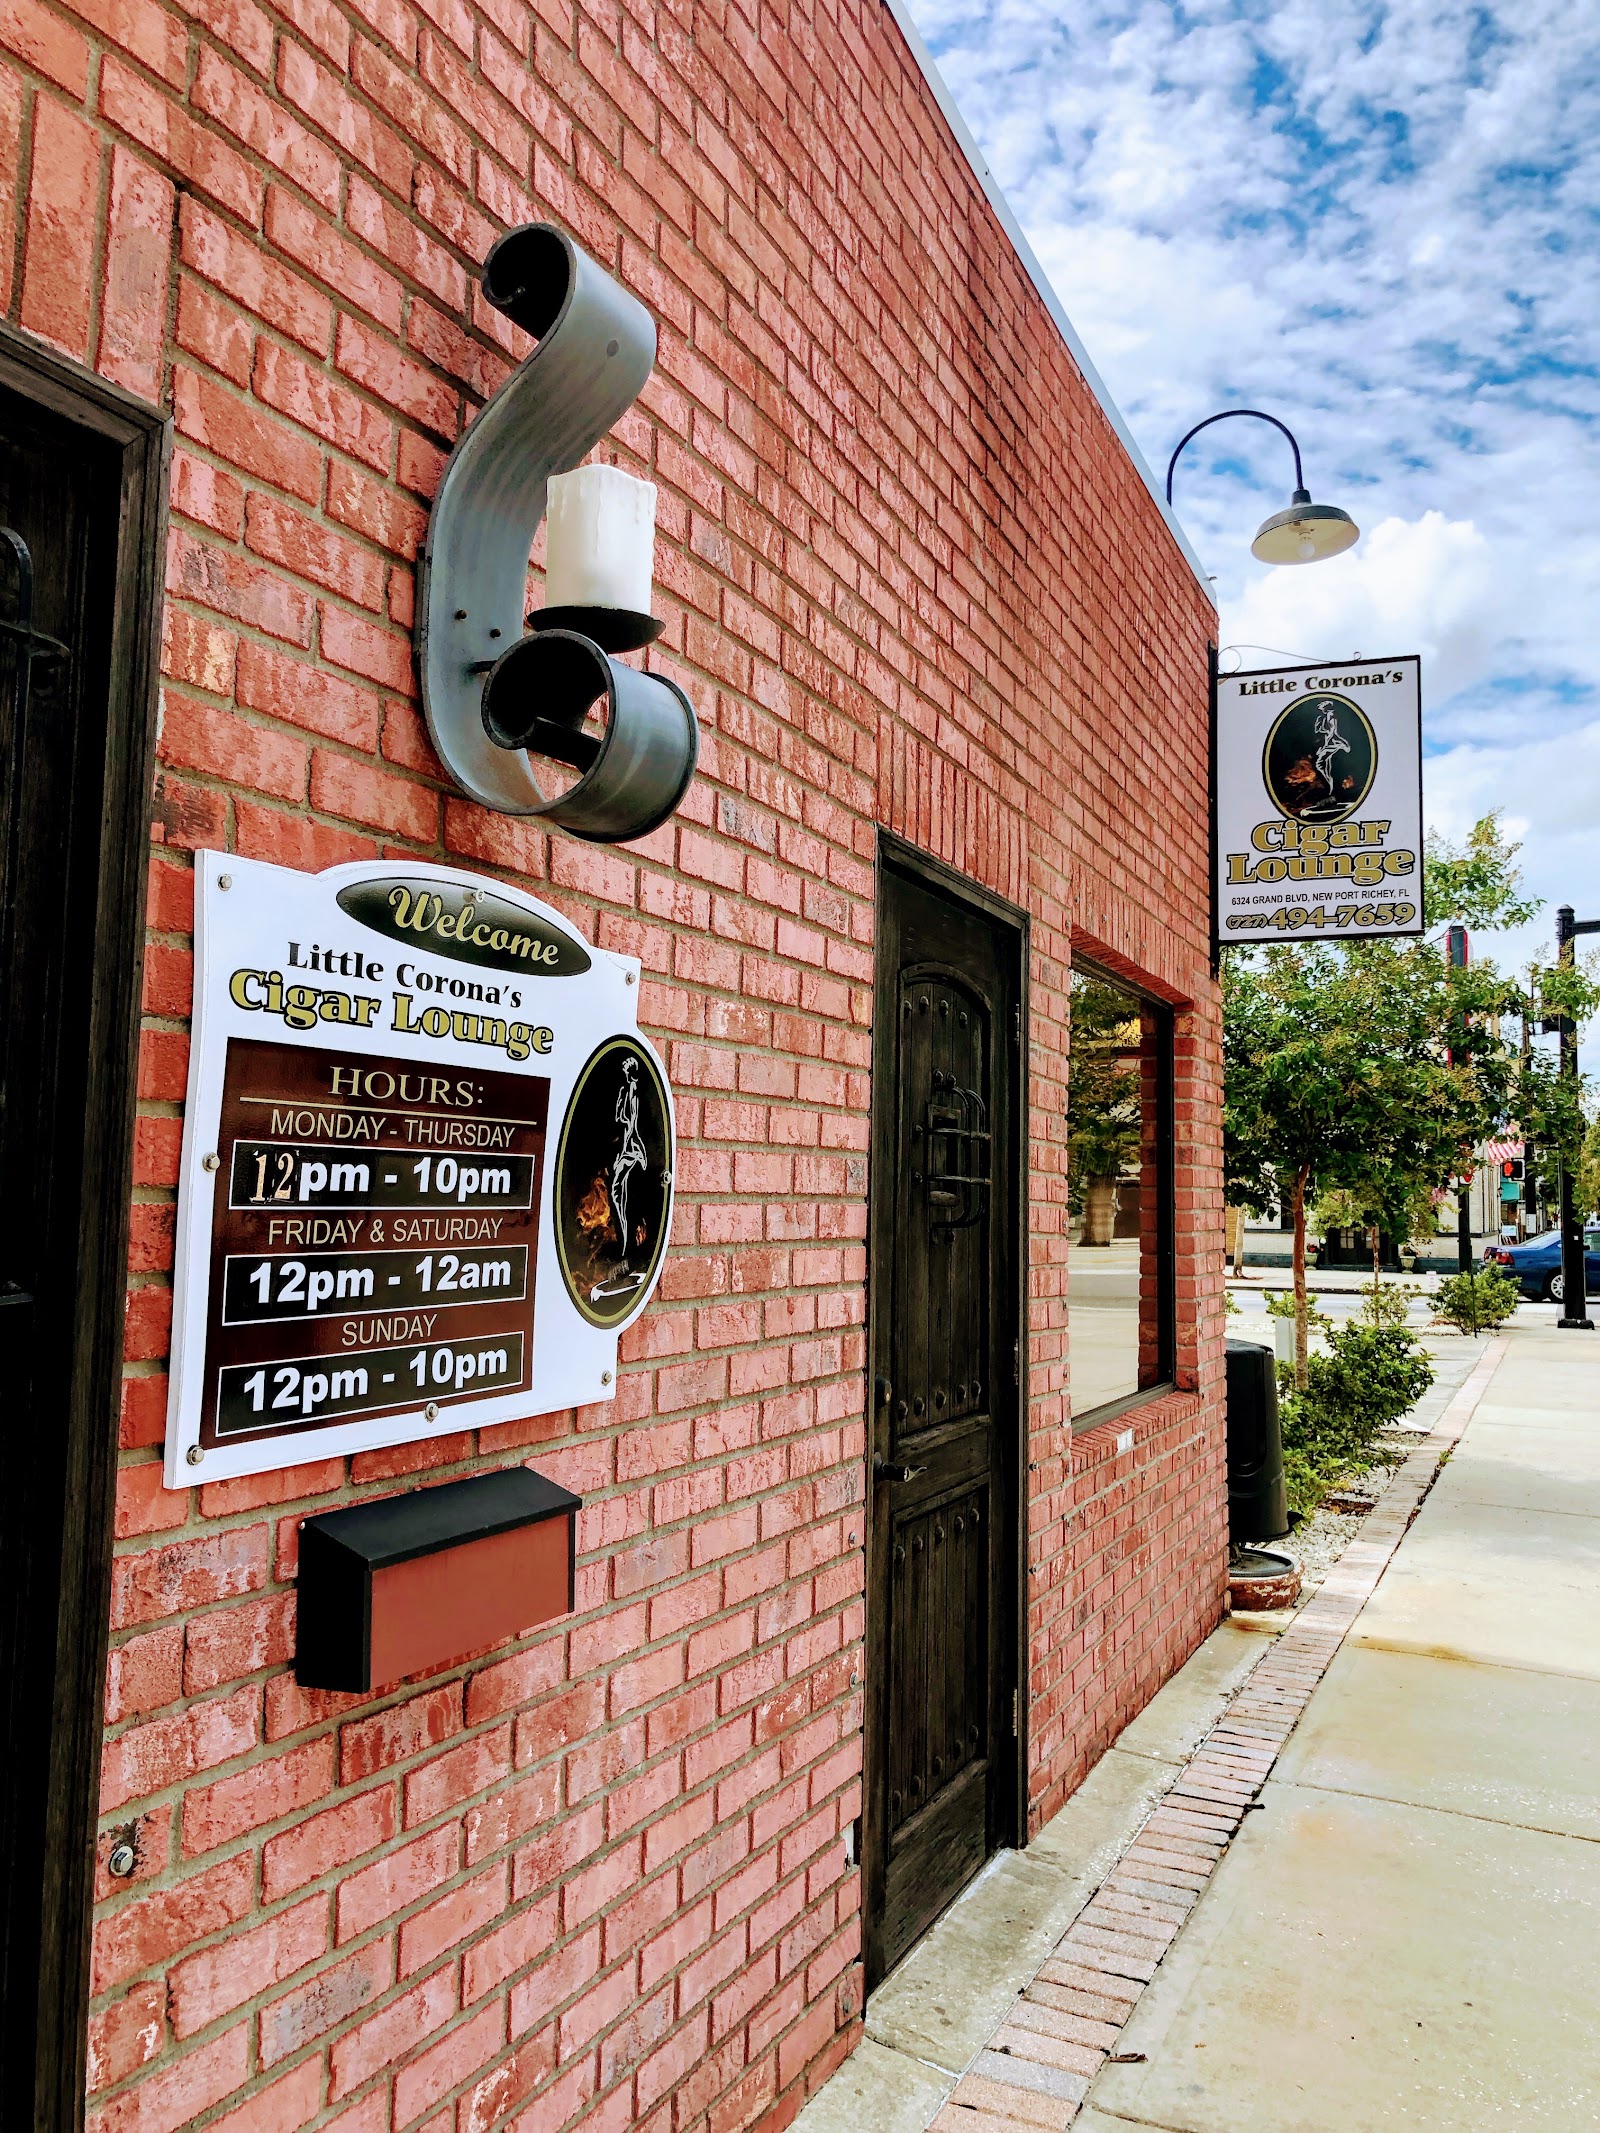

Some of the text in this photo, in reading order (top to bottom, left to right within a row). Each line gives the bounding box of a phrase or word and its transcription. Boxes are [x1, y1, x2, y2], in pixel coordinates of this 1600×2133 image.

[1239, 670, 1403, 696] Little Corona's
[1250, 818, 1392, 856] Cigar
[1226, 849, 1415, 886] Lounge
[1231, 888, 1410, 906] 6324 GRAND BLVD, NEW PORT RICHEY, FL
[388, 885, 560, 966] Welcome
[287, 941, 523, 1009] Little Corona's
[228, 967, 554, 1061] Cigar Lounge
[329, 1065, 485, 1107] HOURS:
[271, 1108, 389, 1141] MONDAY
[404, 1118, 516, 1148] THURSDAY
[250, 1151, 369, 1203] 12pm
[412, 1157, 511, 1202] 10pm
[268, 1217, 503, 1245] FRIDAY & SATURDAY
[249, 1261, 374, 1310] 12pm
[414, 1255, 511, 1293] 12am
[342, 1314, 437, 1346] SUNDAY
[243, 1367, 368, 1412] 12pm
[409, 1347, 507, 1387] 10pm
